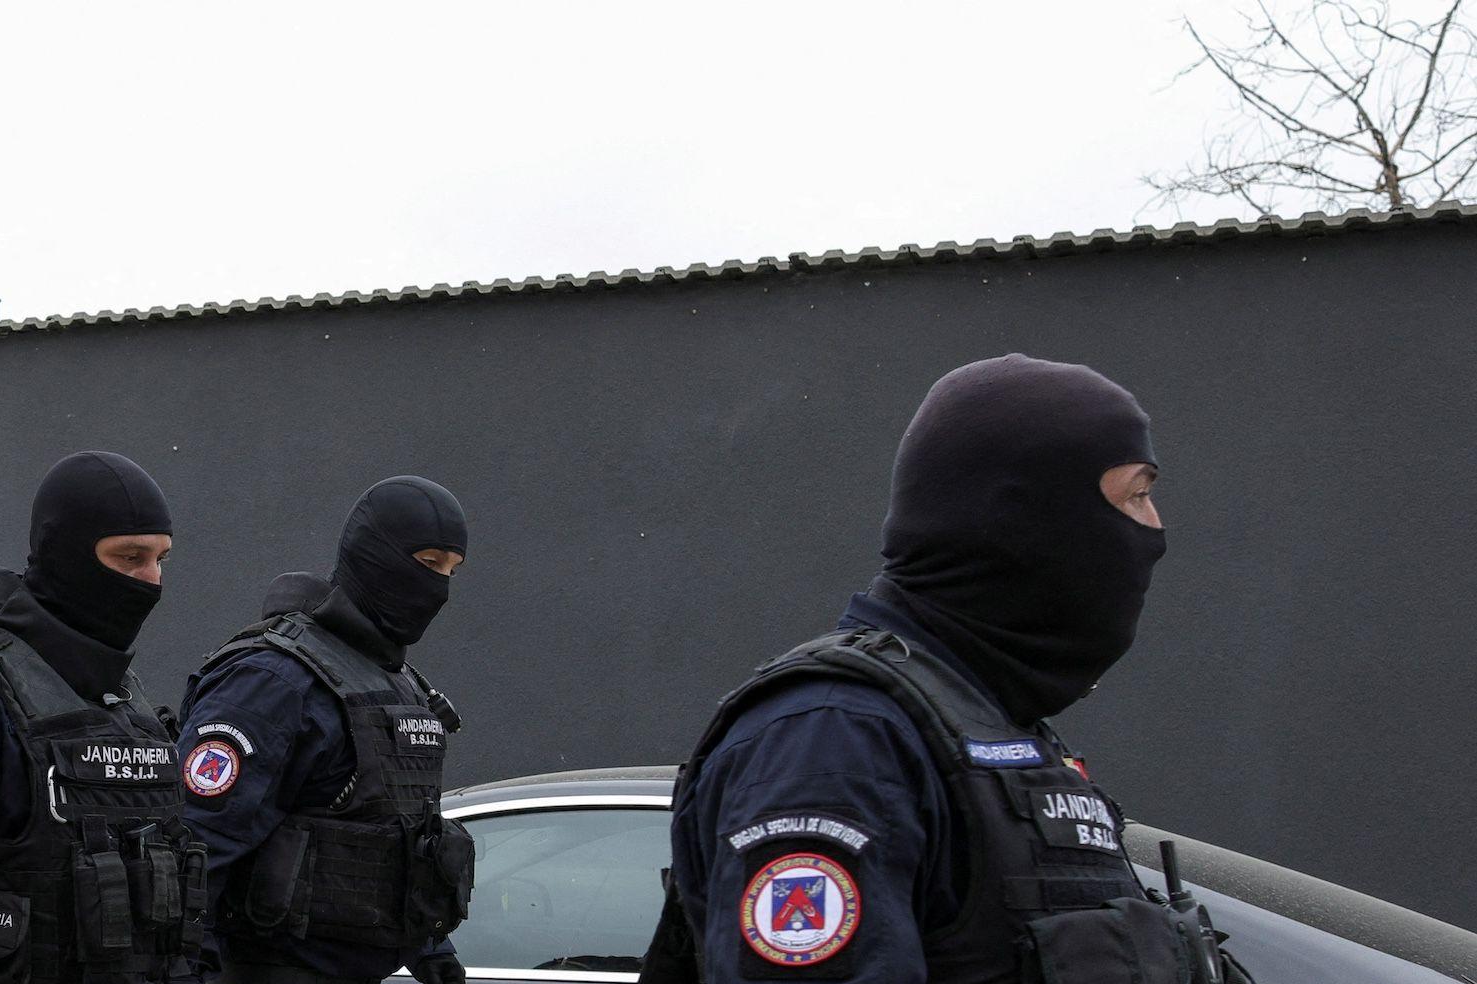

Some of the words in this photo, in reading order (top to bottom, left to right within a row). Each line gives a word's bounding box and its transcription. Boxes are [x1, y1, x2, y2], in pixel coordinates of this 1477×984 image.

[397, 718, 444, 736] JANDARMERIA
[81, 745, 171, 765] JANDARMERIA
[104, 764, 158, 780] B.S.I.J.
[728, 824, 767, 850] BRIGADA
[766, 817, 805, 835] SPECIALA
[805, 817, 820, 832] DE
